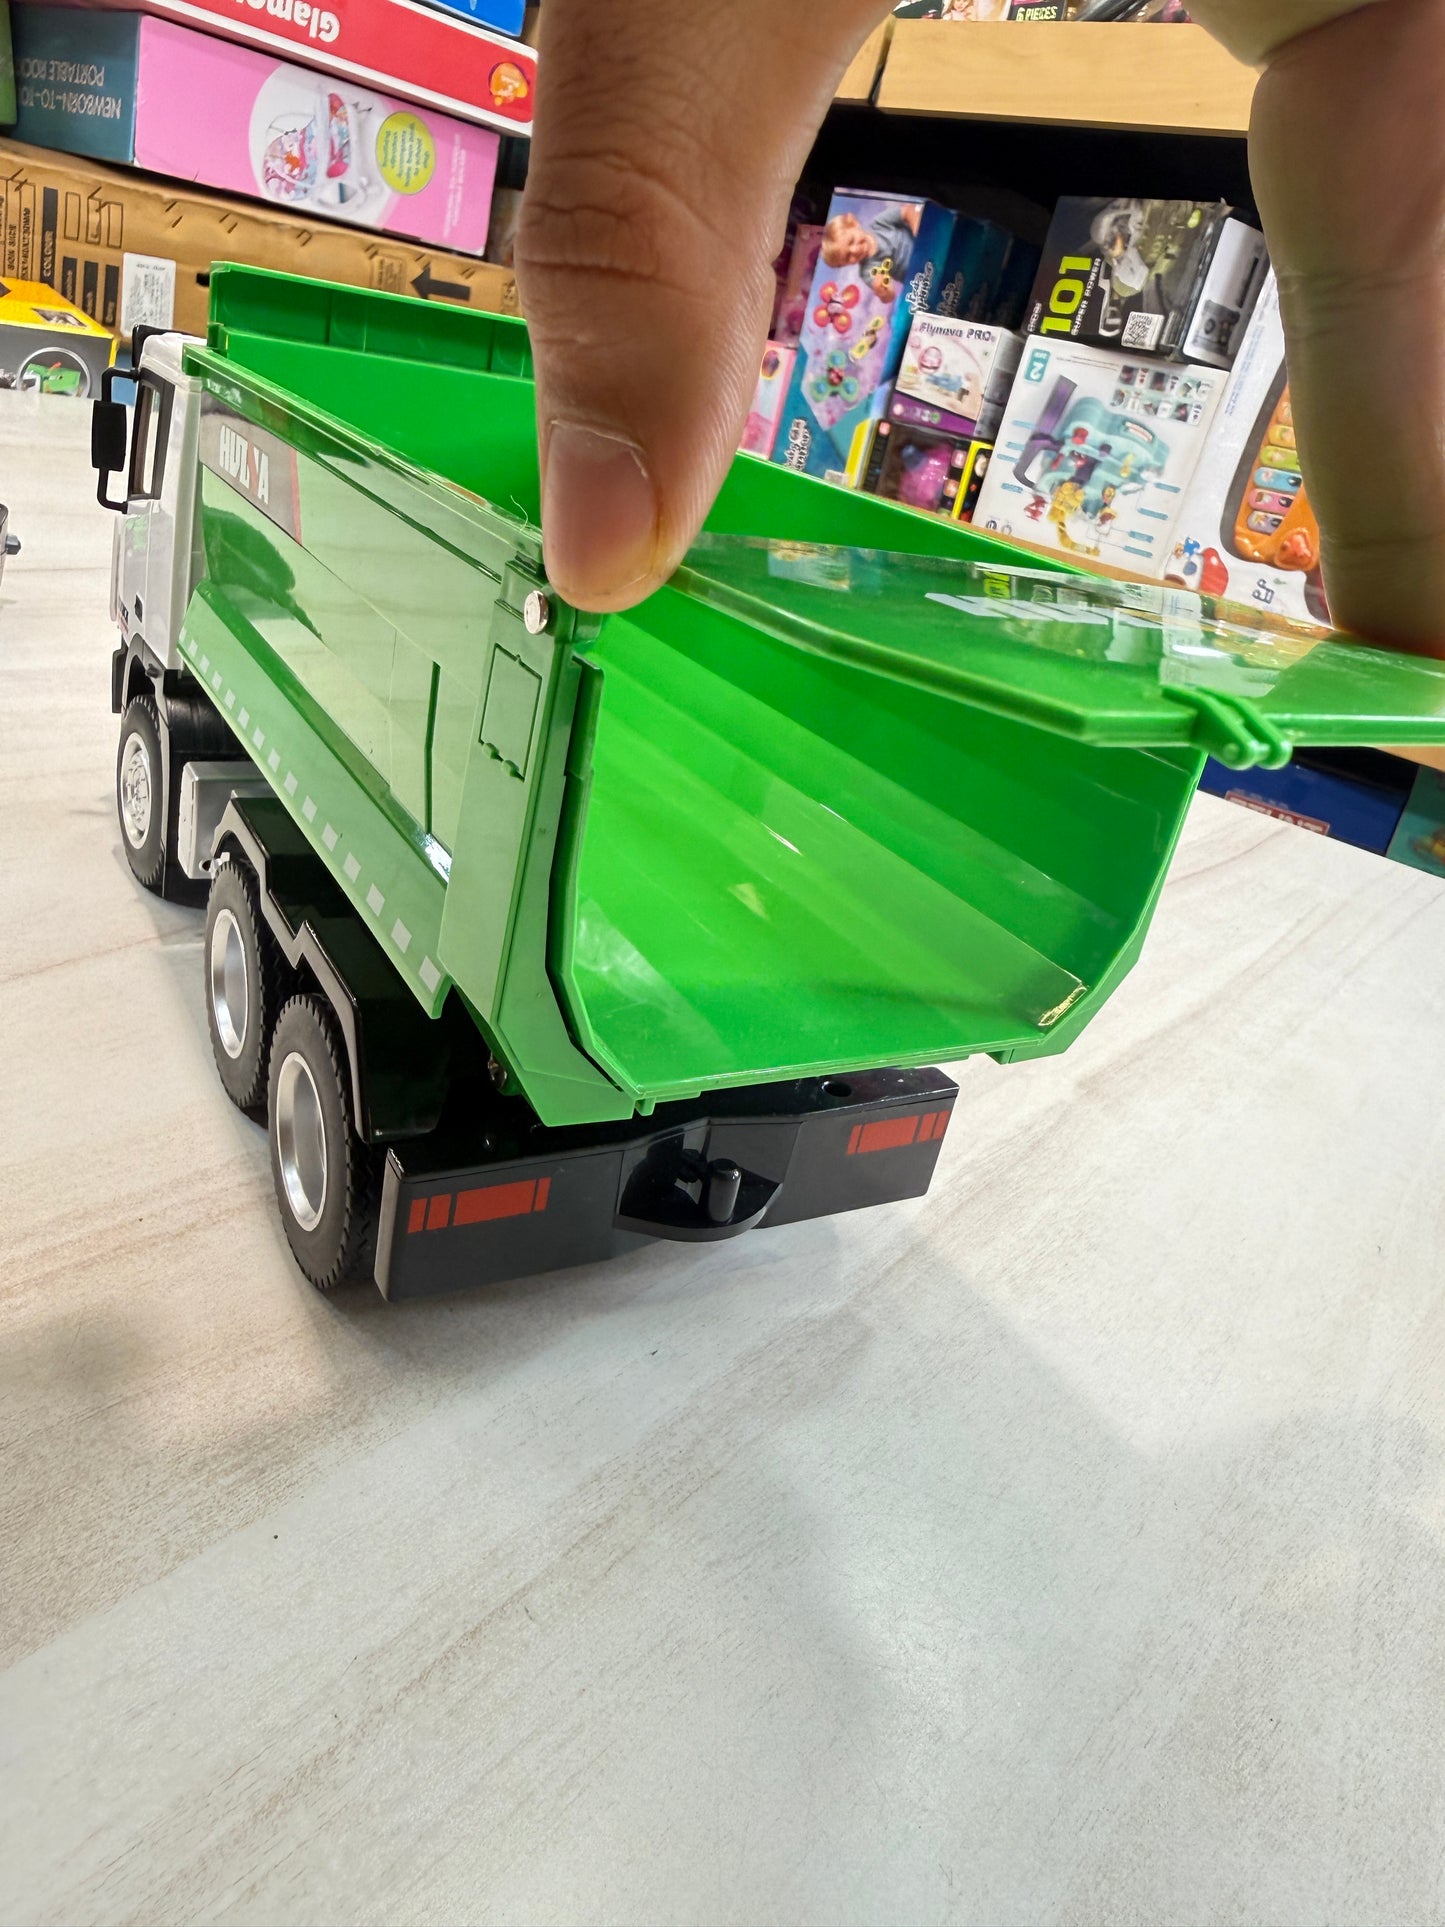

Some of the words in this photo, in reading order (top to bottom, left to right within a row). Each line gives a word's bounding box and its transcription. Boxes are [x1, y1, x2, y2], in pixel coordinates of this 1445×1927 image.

[1026, 6, 1058, 20] PIECES
[49, 60, 105, 87] PORTABLE
[1085, 257, 1102, 297] POWER
[1040, 256, 1092, 334] 101
[966, 327, 992, 341] PRO
